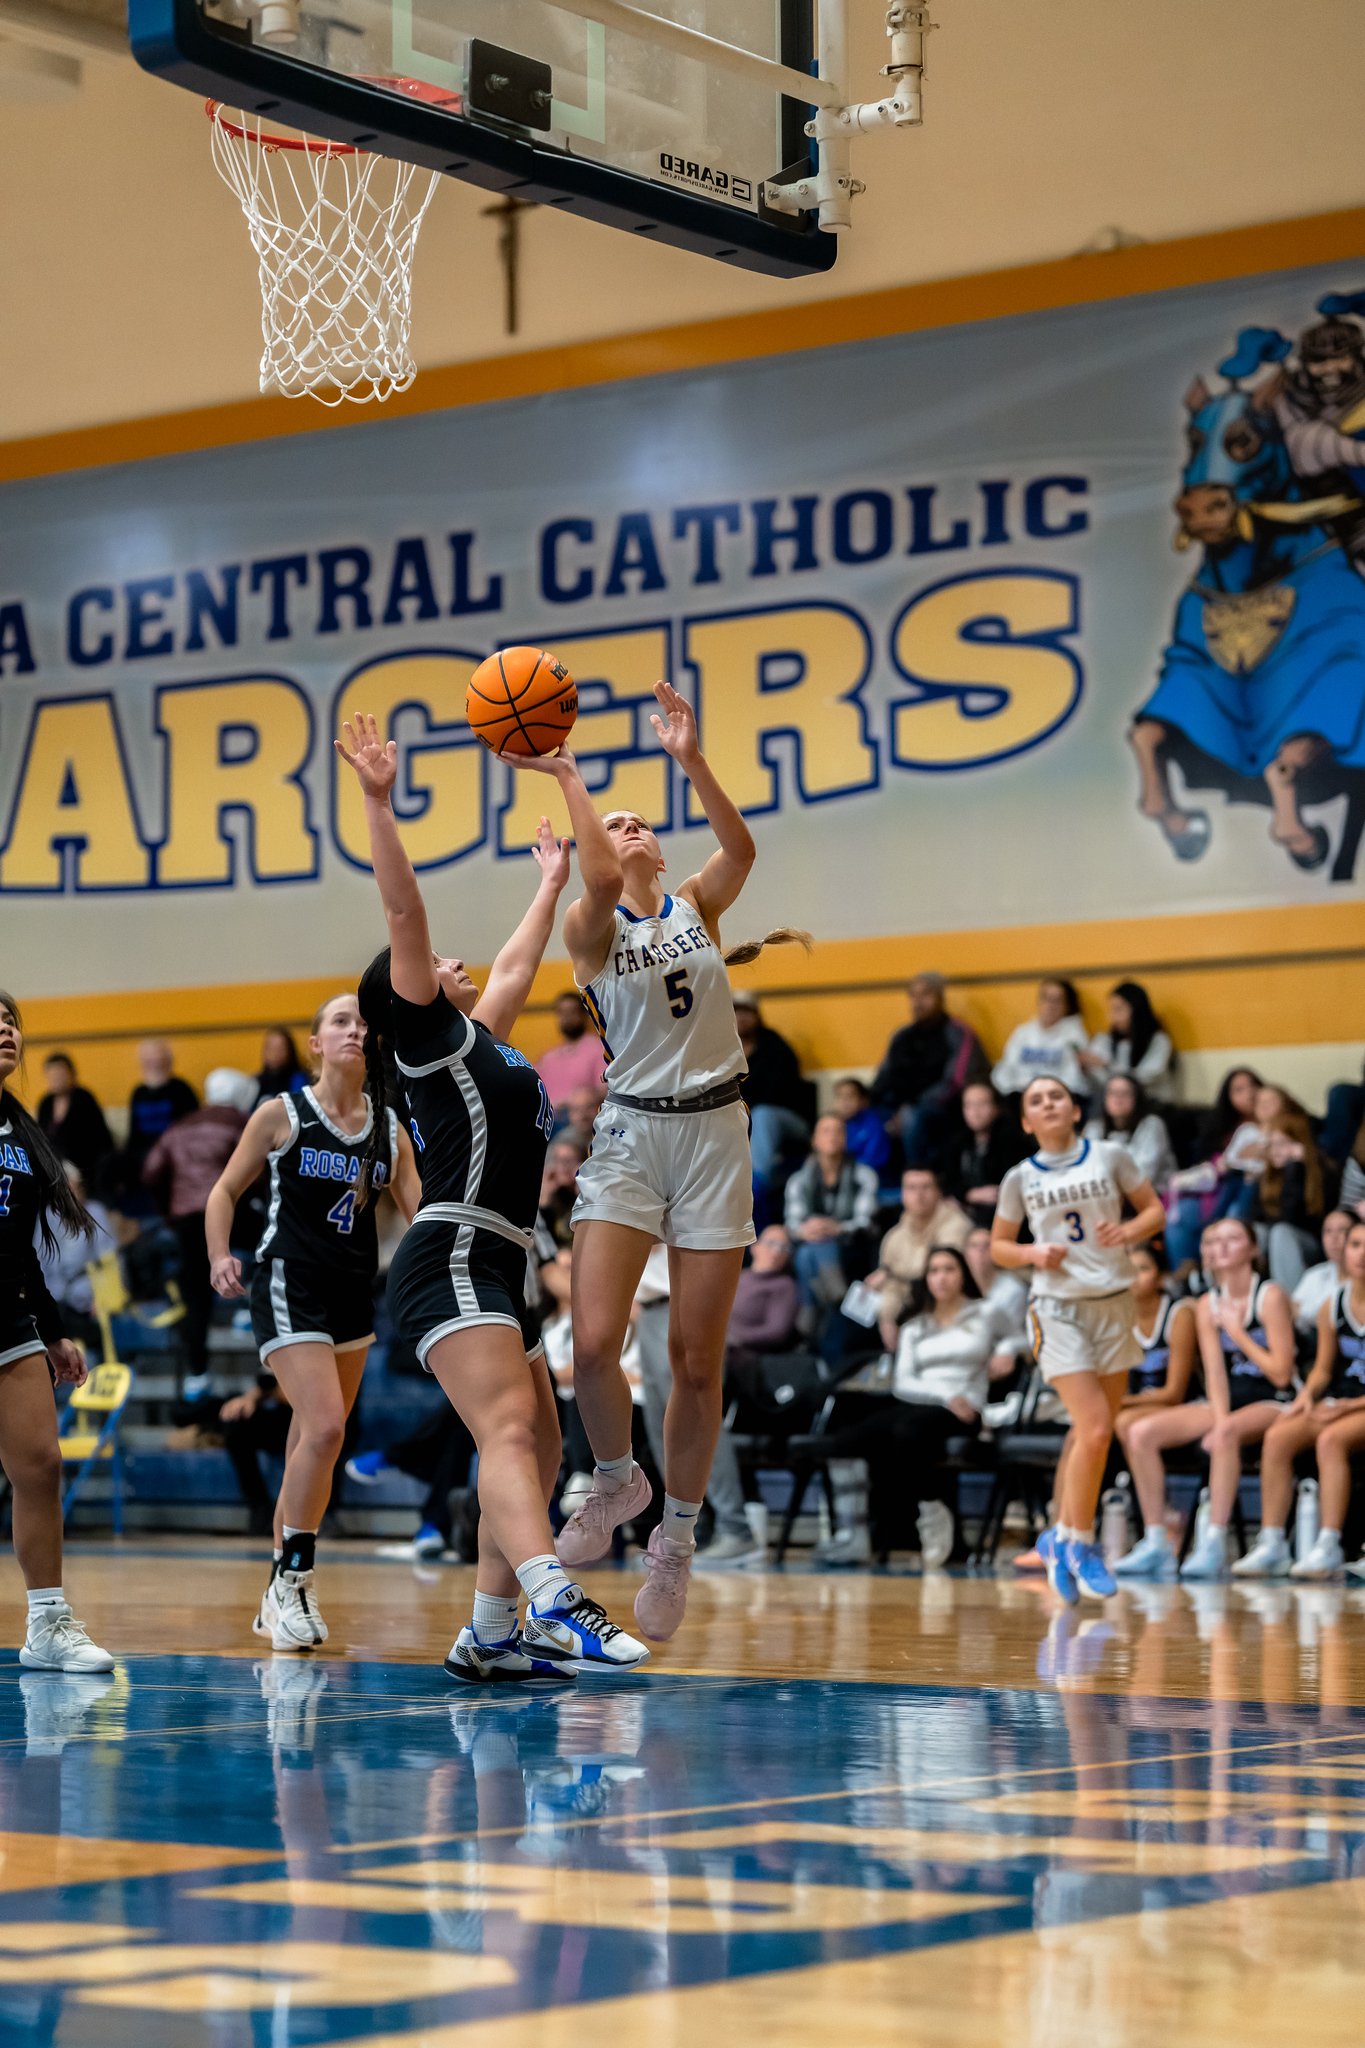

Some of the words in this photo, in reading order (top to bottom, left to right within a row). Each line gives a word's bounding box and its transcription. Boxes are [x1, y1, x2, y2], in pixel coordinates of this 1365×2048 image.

[66, 530, 503, 667] CENTRAL
[540, 475, 1090, 604] CATHOLIC
[613, 925, 712, 977] CHARGERS
[663, 968, 694, 1020] 5
[326, 1189, 357, 1234] 4
[1065, 1211, 1085, 1242] 3
